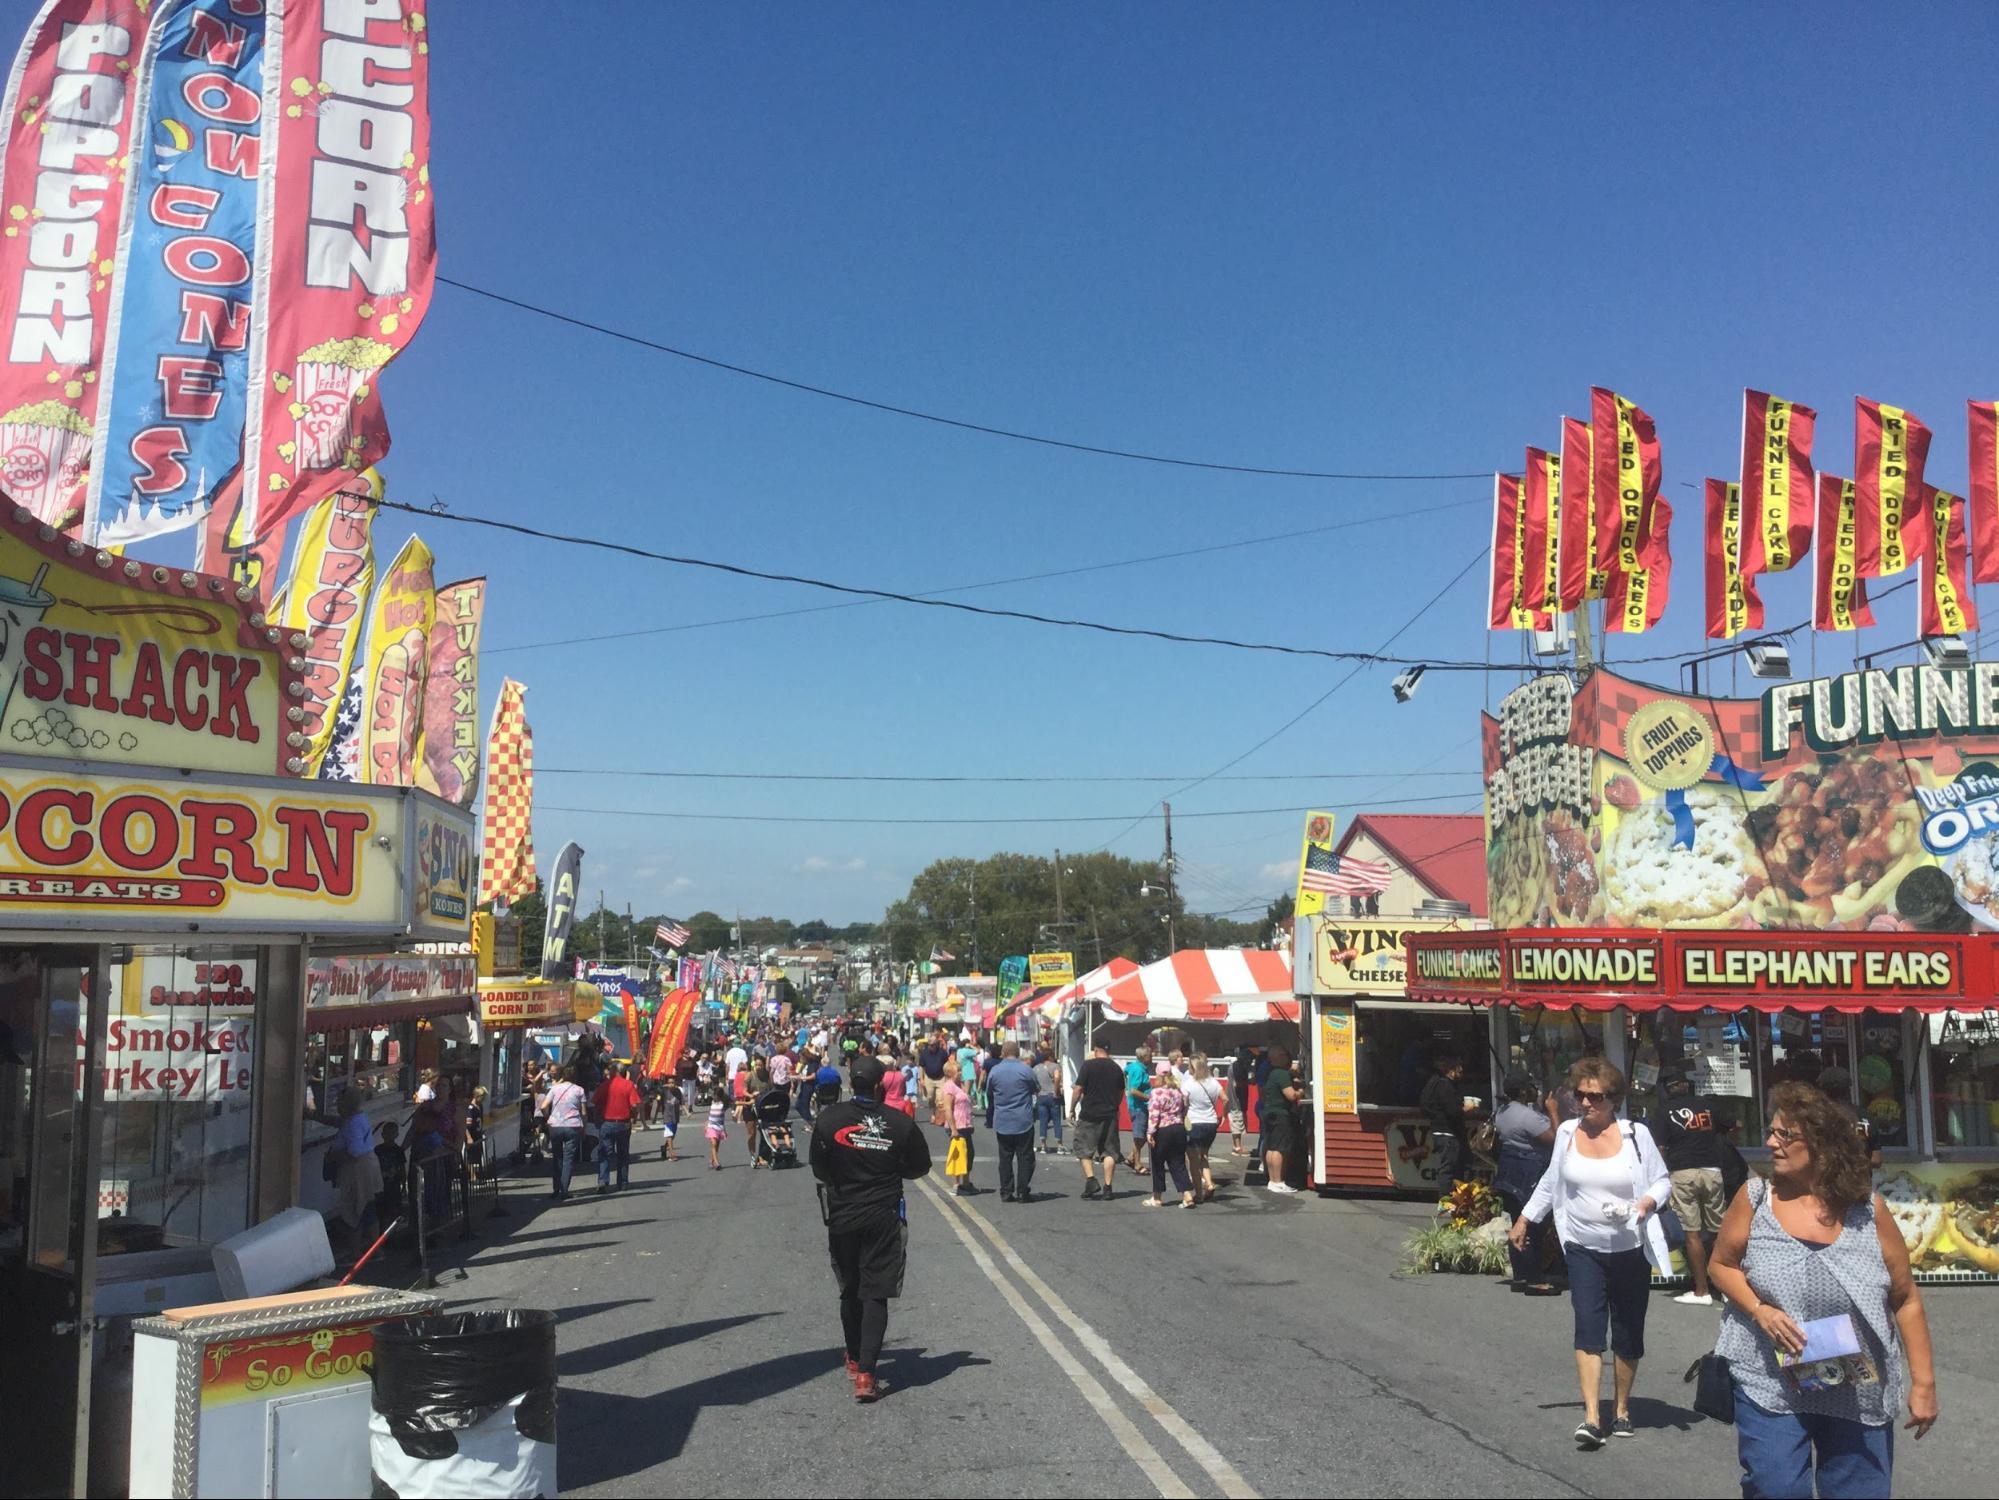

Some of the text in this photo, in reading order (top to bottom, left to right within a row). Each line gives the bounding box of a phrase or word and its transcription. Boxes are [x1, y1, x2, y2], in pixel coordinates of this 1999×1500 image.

[8, 22, 131, 366] POPCORN
[130, 183, 252, 494] CONES
[1768, 402, 1785, 566] FUNNEL CAKE
[1621, 489, 1640, 565] OREOS
[1885, 496, 1901, 570] DOUGH
[1833, 564, 1851, 626] DOUGH
[1938, 584, 1960, 627] CAKE
[23, 625, 261, 745] SHACK
[1642, 716, 1679, 750] FRUIT
[1643, 726, 1703, 775] TOPPINGS
[1915, 782, 1966, 813] Deep
[1926, 798, 1999, 848] OR
[430, 822, 469, 893] SNO
[434, 898, 463, 916] KONES
[545, 873, 574, 962] ATM
[1416, 947, 1501, 979] FUNNEL CAKES
[1511, 949, 1656, 983] LEMONADE
[1685, 949, 1951, 985] ELEPHANT EARS
[480, 991, 528, 1002] LOADED
[489, 1004, 522, 1015] CORN
[107, 1019, 250, 1053] Smoked
[74, 1059, 202, 1097] Trkey
[245, 1358, 293, 1392] So
